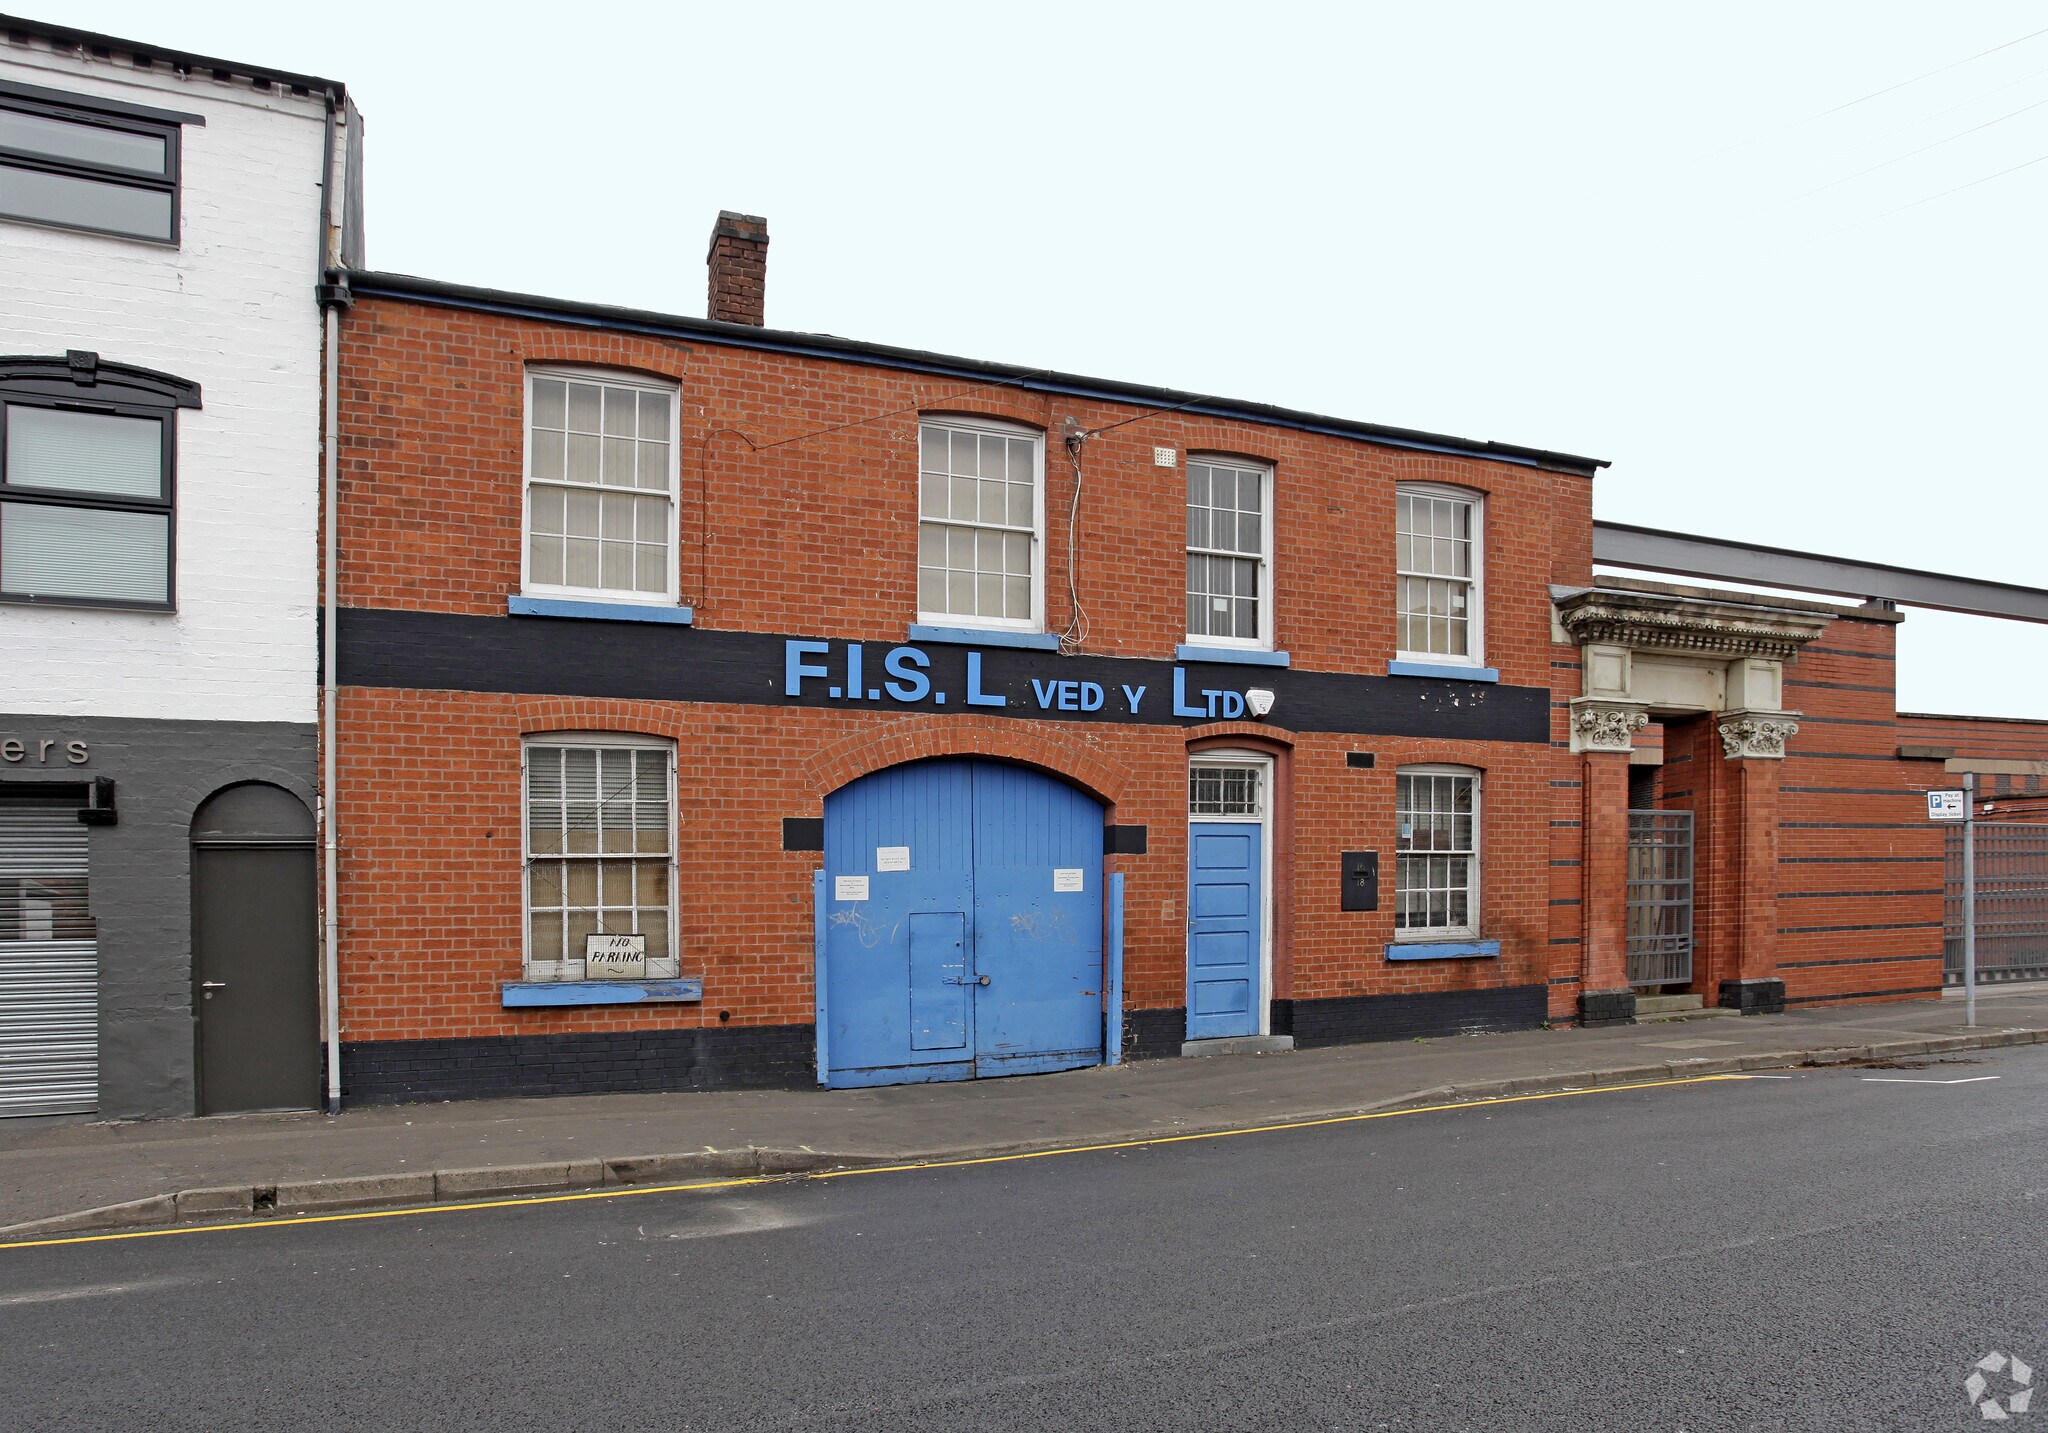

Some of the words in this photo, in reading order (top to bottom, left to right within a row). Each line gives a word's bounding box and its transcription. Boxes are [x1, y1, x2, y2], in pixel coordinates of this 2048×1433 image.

[1031, 679, 1105, 712] VED
[1357, 878, 1365, 887] 18
[610, 938, 630, 947] NO
